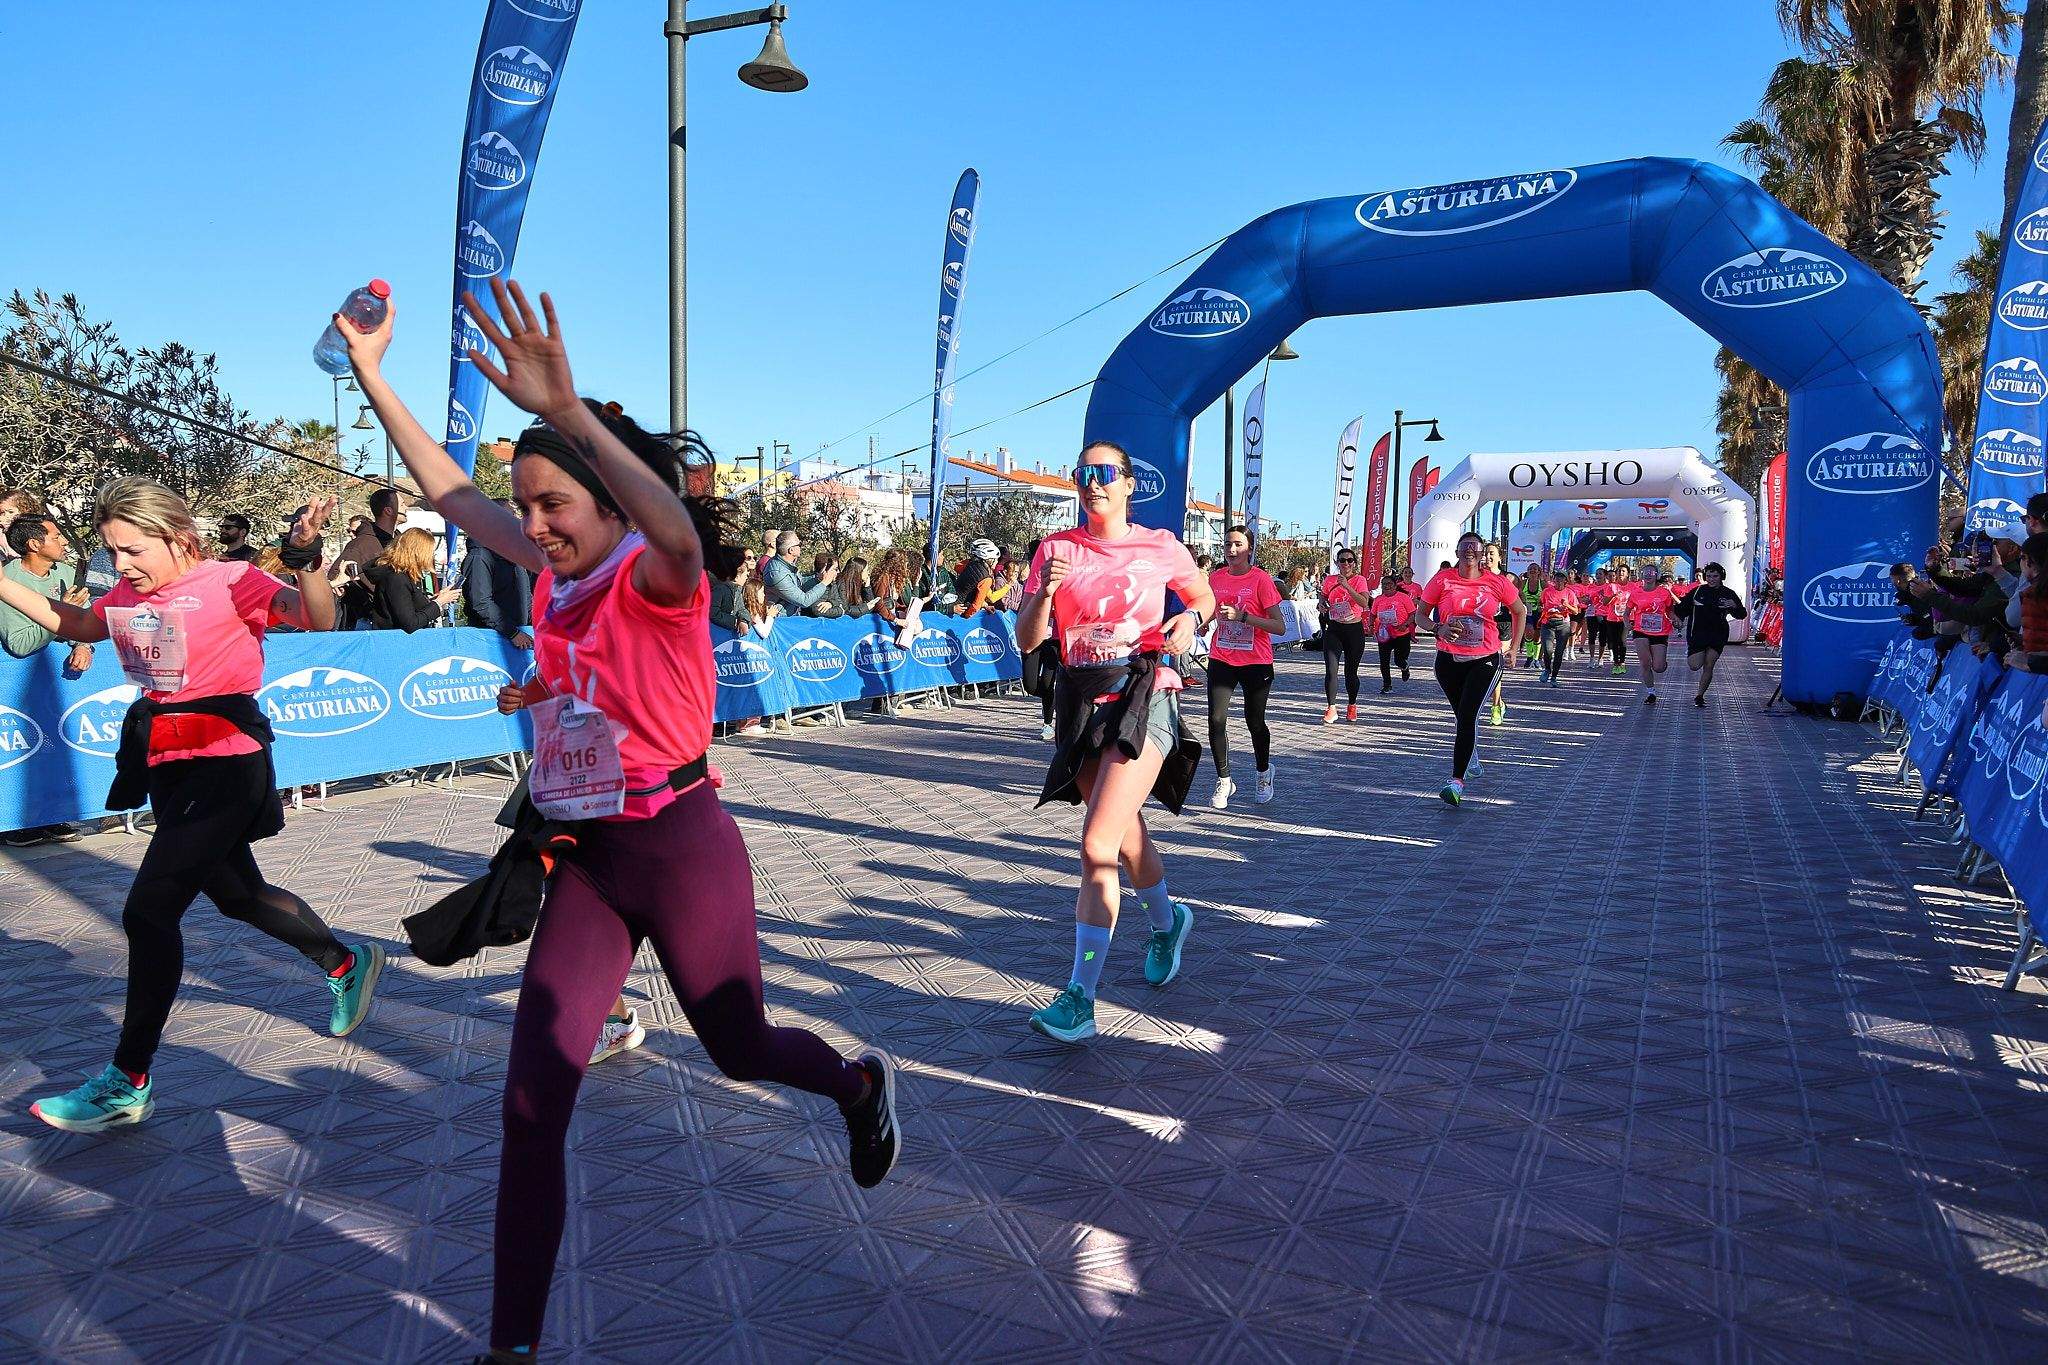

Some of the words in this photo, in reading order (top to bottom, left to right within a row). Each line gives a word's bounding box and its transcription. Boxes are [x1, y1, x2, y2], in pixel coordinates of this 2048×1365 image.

[485, 60, 547, 97] ASTURIANA
[1406, 182, 1474, 196] CENTRAL
[1482, 172, 1553, 188] LECHERA
[1369, 177, 1558, 222] ASTURIANA
[1732, 267, 1781, 279] CENTRAL
[1784, 263, 1831, 273] LECHERA
[1712, 270, 1838, 298] ASTURIANA
[1171, 303, 1201, 312] CENTRAL
[1154, 310, 1242, 327] ASTURIANA
[1834, 453, 1882, 462] CENTRAL
[1508, 460, 1643, 488] OYSHO
[1814, 457, 1929, 481] ASTURIANA
[1373, 454, 1384, 521] Santander
[1682, 487, 1726, 496] OYSHO
[1433, 492, 1471, 501] OYSHO
[1829, 582, 1876, 590] CENTRAL
[133, 645, 161, 660] 016
[915, 643, 958, 659] ASTURIANA
[967, 641, 1003, 656] ASTURIANA
[792, 655, 844, 673] ASTURIANA
[856, 649, 904, 667] ASTURIANA
[713, 660, 771, 677] ASTURIANA
[425, 677, 465, 687] CENTRAL
[467, 674, 505, 683] LECHERA
[282, 690, 328, 701] CENTRAL
[331, 687, 374, 696] LECHERA
[411, 681, 507, 707] ASTURIAN
[267, 695, 383, 723] ASTURIANA
[562, 746, 597, 771] 016
[569, 774, 587, 786] 2122
[541, 791, 563, 800] CARRERA
[563, 789, 571, 797] DE
